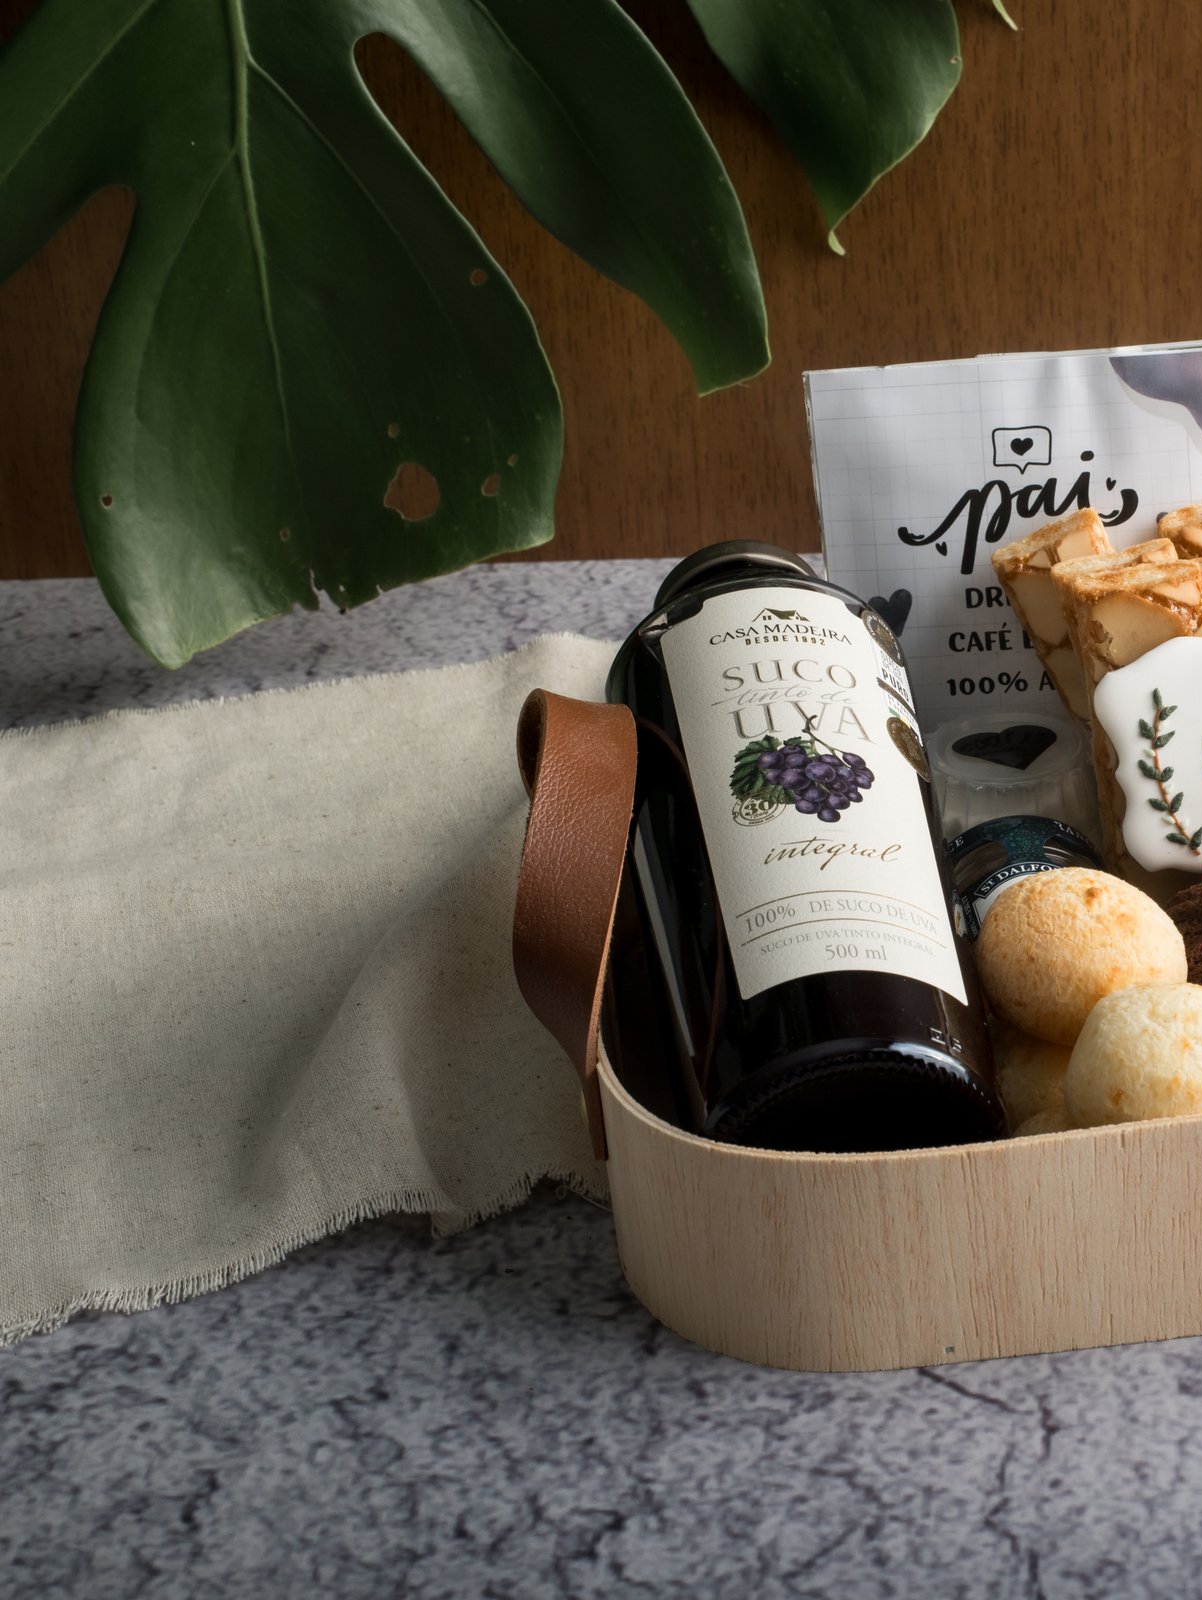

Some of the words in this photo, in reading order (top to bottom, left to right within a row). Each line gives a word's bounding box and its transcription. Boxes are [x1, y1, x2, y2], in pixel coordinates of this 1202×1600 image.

[898, 450, 1139, 575] pai
[709, 626, 757, 645] CASA
[764, 624, 852, 645] MADEIRA
[745, 635, 788, 646] DESDE
[795, 635, 826, 646] 1992
[948, 622, 1012, 653] CAFÉ
[722, 659, 857, 692] SUCO
[946, 671, 1029, 695] 100%
[711, 684, 813, 706] tinto
[820, 688, 857, 704] de
[728, 700, 877, 744] UVA
[764, 836, 902, 870] integral
[980, 879, 996, 893] ST
[998, 863, 1058, 880] DALFO
[746, 903, 796, 933] 100%
[809, 900, 834, 914] DE
[838, 899, 882, 914] SUCO
[886, 904, 908, 921] DE
[911, 911, 938, 935] UVA
[761, 937, 793, 955] SUCO
[796, 934, 812, 944] DE
[815, 930, 840, 940] UVA
[840, 929, 881, 940] TINTO
[883, 932, 935, 956] INTEGRAL
[825, 944, 859, 961] 500
[866, 945, 887, 961] ml
